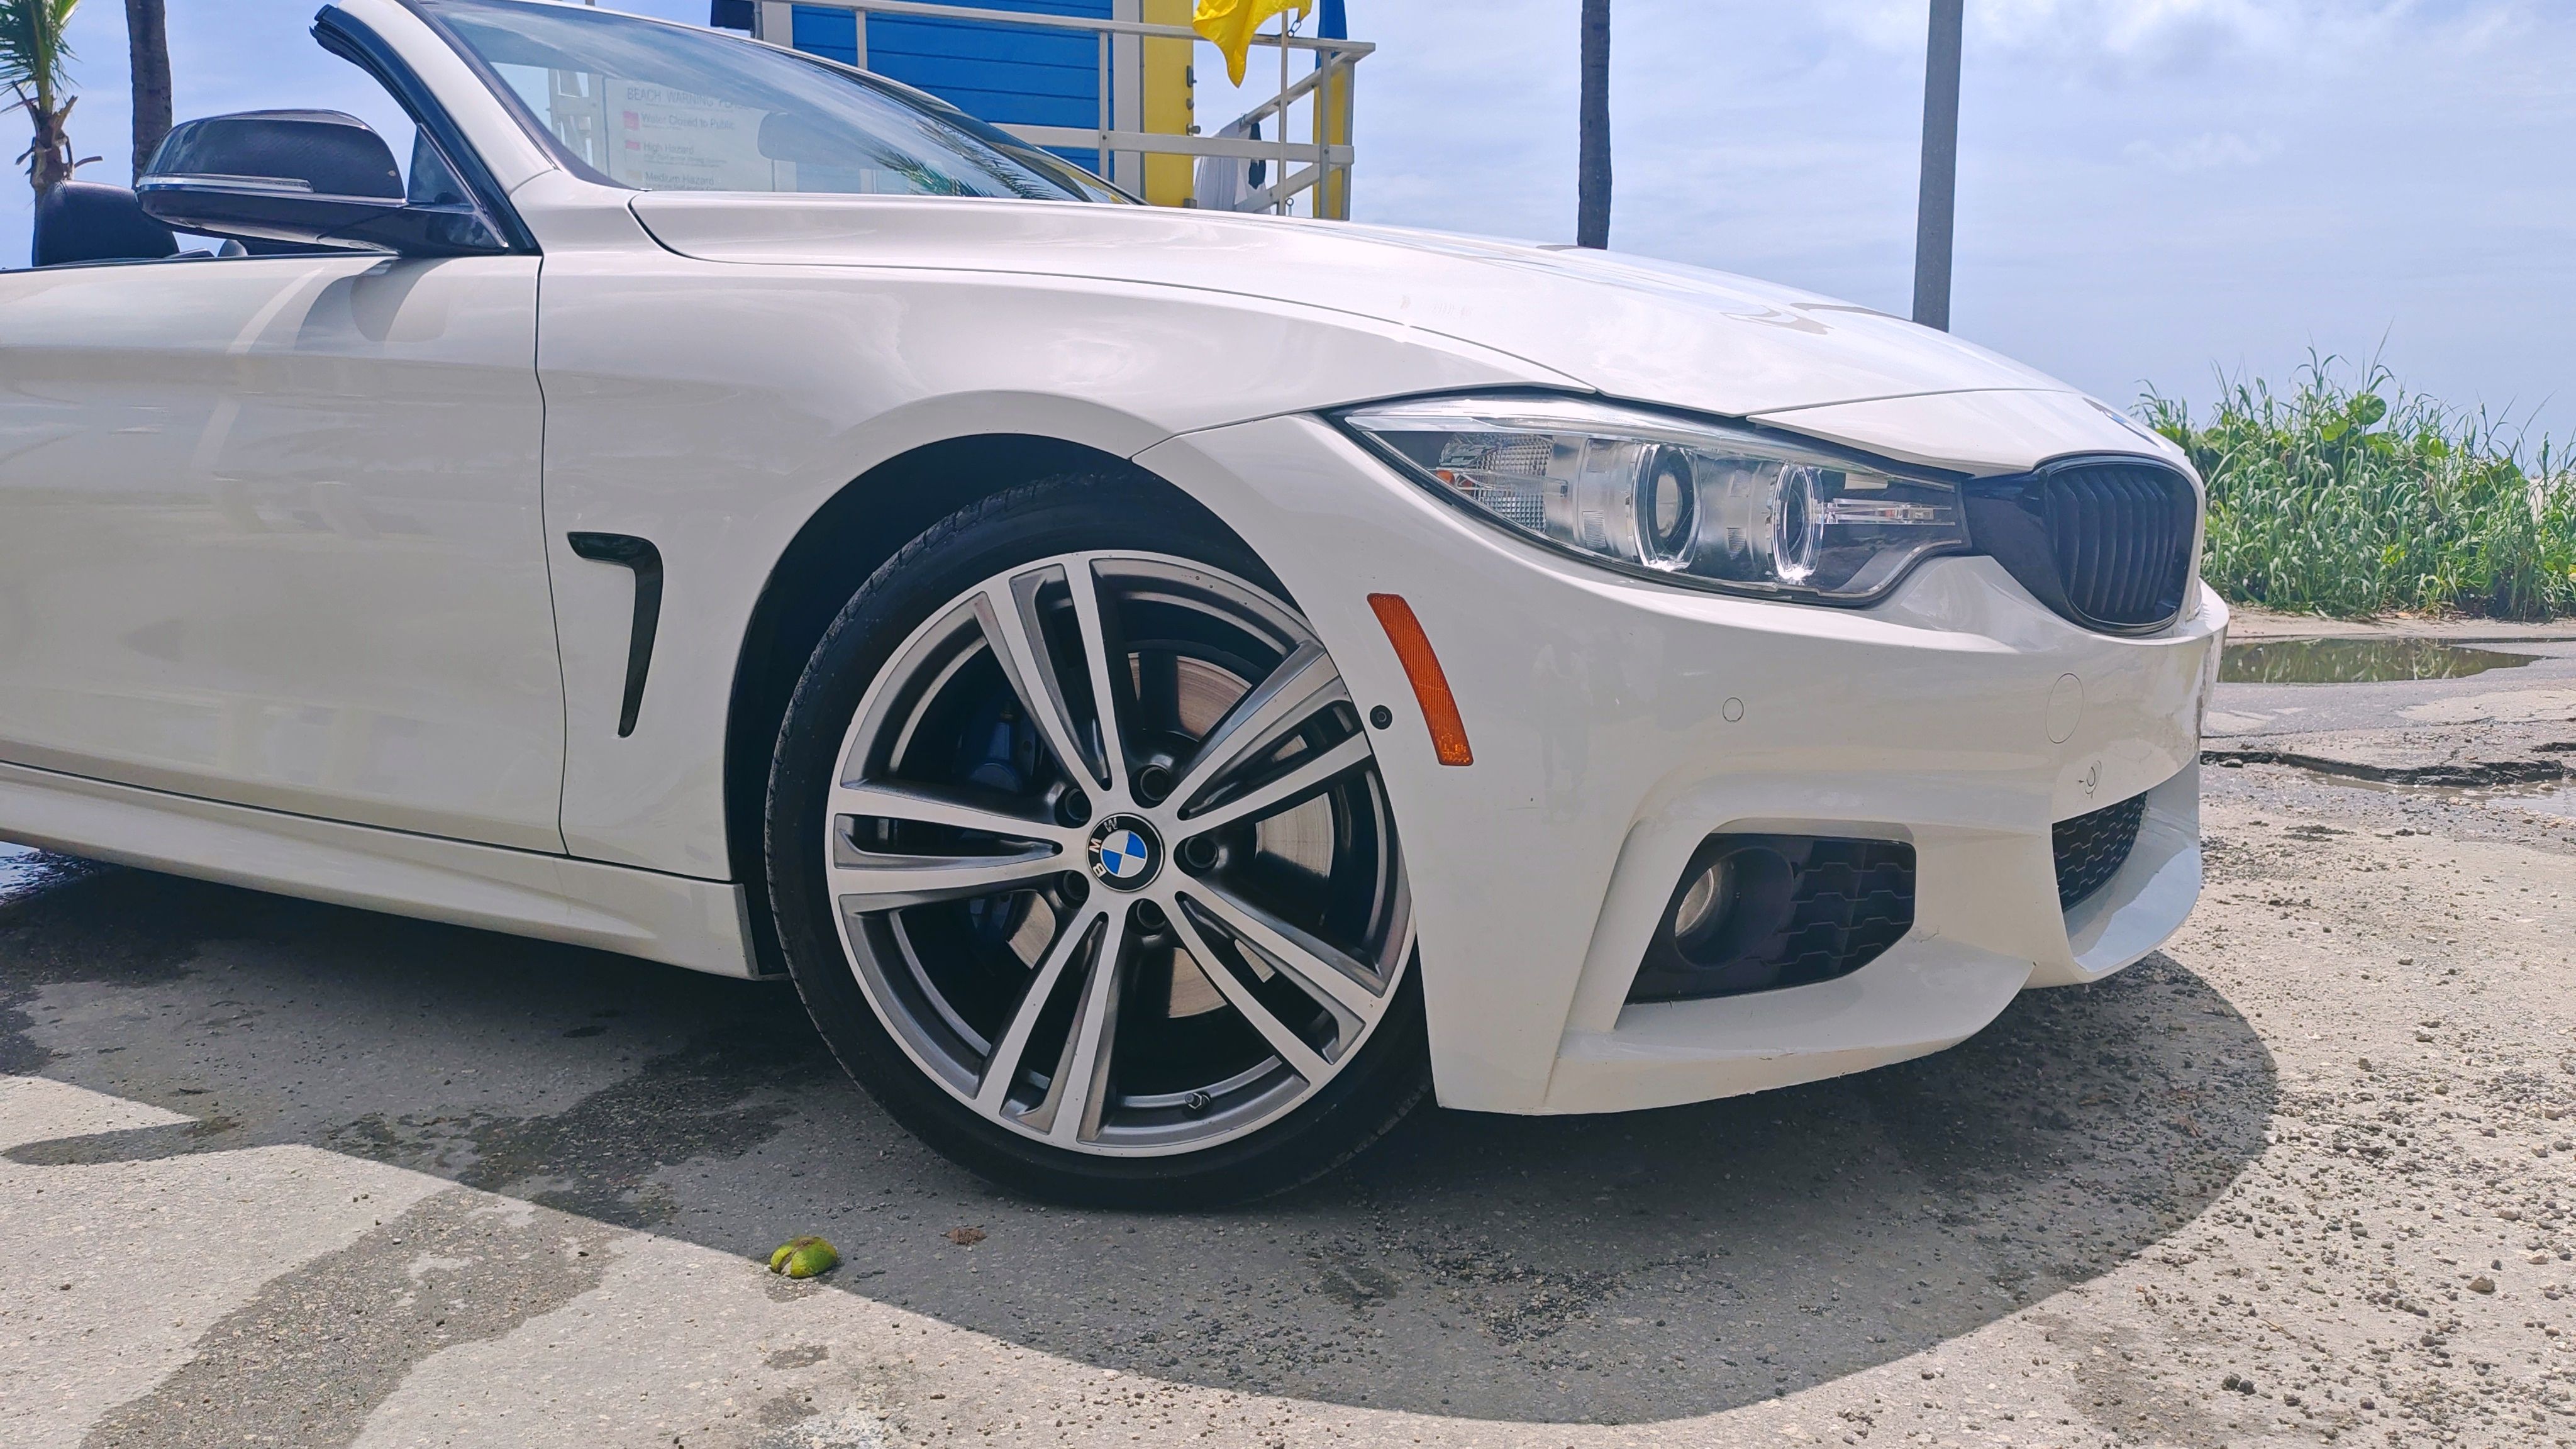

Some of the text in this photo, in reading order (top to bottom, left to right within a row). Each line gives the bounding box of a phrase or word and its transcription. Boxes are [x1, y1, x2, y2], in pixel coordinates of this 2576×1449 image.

[628, 87, 661, 101] BEACH
[667, 90, 714, 106] WARNING
[645, 172, 714, 185] Medium Hazard
[1088, 817, 1118, 877] BMW
